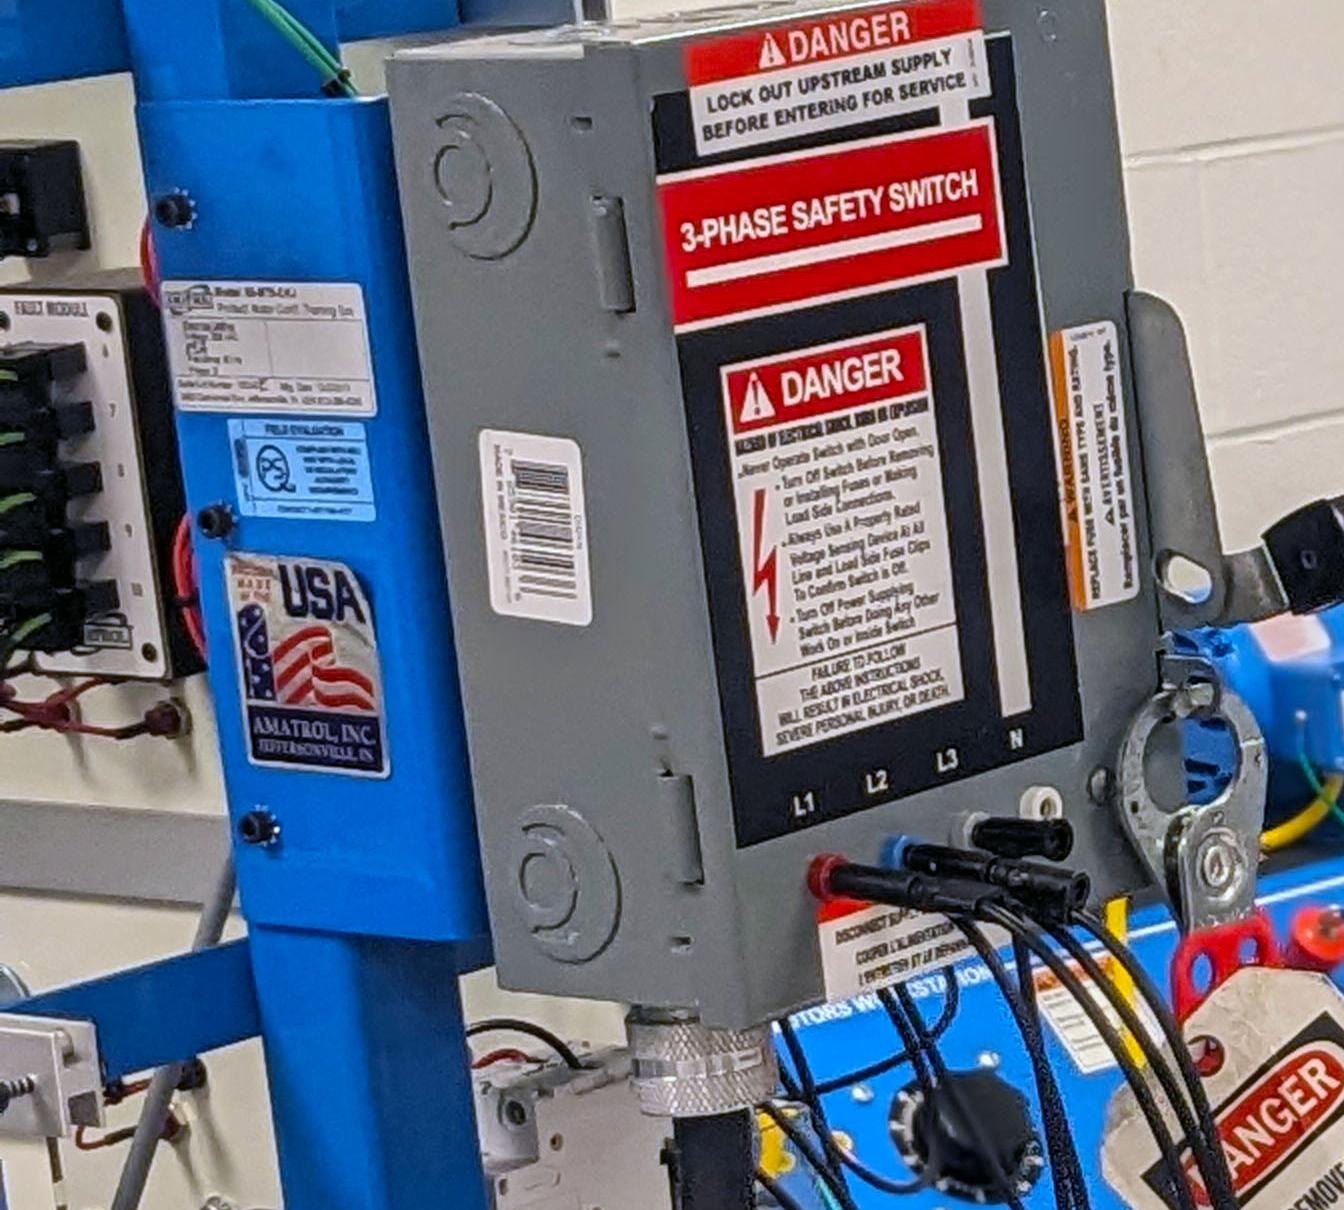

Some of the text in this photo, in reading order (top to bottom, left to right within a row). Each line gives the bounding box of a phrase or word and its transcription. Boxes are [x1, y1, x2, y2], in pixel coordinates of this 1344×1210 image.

[789, 12, 911, 62] DANGER
[707, 88, 754, 114] LOCK
[759, 81, 792, 102] OUT
[799, 61, 887, 94] UPSTREAM
[891, 48, 952, 76] SUPPLY
[702, 72, 967, 142] BEFORE ENTERING FOR SERVICE
[680, 168, 979, 253] 3-PHASE SAFETY SWITCH
[780, 349, 903, 407] DANGER
[1073, 394, 1084, 418] AND
[1075, 420, 1088, 449] TYPE
[1109, 416, 1119, 432] du
[812, 441, 844, 462] Switch
[846, 436, 866, 452] with
[868, 430, 891, 447] Door
[781, 443, 936, 491] Turn Off Switch Before Removing
[841, 477, 871, 493] Fuses
[872, 475, 883, 487] or
[785, 509, 811, 526] Load
[812, 503, 833, 520] Side
[788, 529, 823, 546] Always
[824, 523, 843, 538] Use
[894, 501, 921, 519] Rated
[1117, 499, 1130, 519] par
[828, 539, 866, 558] Sensing
[867, 530, 899, 548] Device
[1084, 518, 1096, 547] FUSE
[791, 539, 932, 586] Line and Load Side Fuse Clips
[1120, 523, 1133, 590] Remplacer
[794, 588, 807, 602] To
[808, 580, 847, 599] Confirm
[848, 570, 880, 588] Switch
[1088, 549, 1101, 600] REPLACE
[278, 563, 367, 625] USA
[796, 608, 819, 624] Turn
[820, 601, 835, 616] Off
[837, 594, 867, 612] Power
[799, 623, 831, 641] Switch
[832, 615, 863, 632] Before
[865, 607, 893, 624] Doing
[913, 592, 940, 610] Other
[800, 642, 825, 658] Work
[827, 637, 841, 651] On
[811, 643, 907, 682] FAILURE TO FOLLOW
[800, 657, 922, 702] THE ABOVE INSTRUCTIONS
[775, 723, 814, 746] SEVERE
[815, 710, 867, 735] PERSONAL
[903, 693, 918, 709] OR
[778, 710, 802, 727] WILL
[803, 698, 840, 719] RESULT
[841, 694, 852, 709] IN
[851, 681, 910, 706] ELECTRICAL
[253, 716, 377, 746] AMATROL, INC.
[1009, 727, 1024, 750] N
[936, 748, 960, 773] L3
[866, 769, 890, 794] L2
[792, 791, 815, 817] L1
